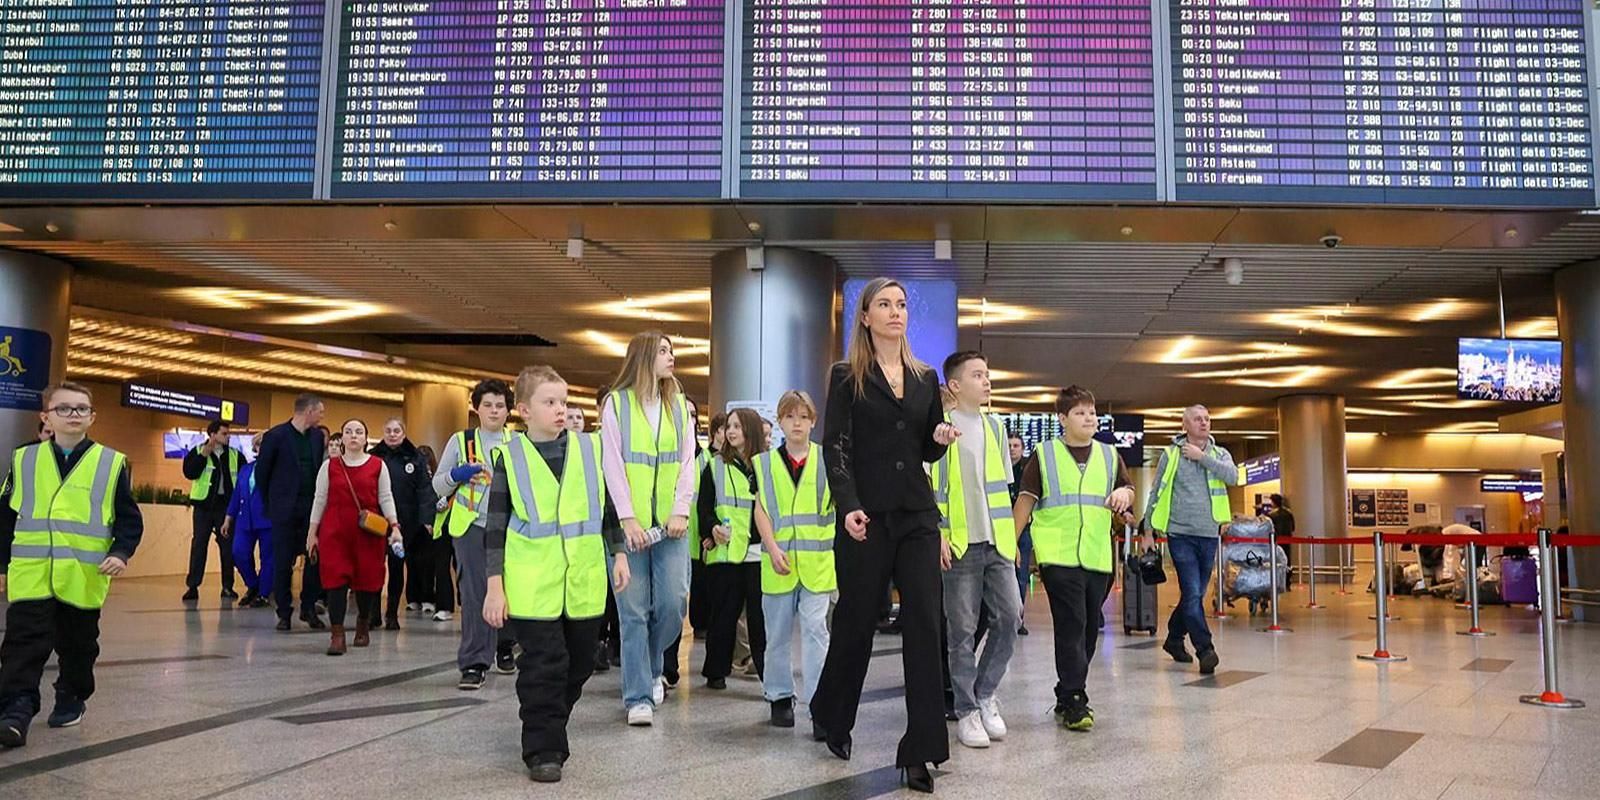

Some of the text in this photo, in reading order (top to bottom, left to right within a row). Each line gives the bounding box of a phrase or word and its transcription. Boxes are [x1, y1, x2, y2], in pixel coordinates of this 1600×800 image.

[130, 9, 145, 17] 414
[204, 7, 214, 16] 23
[754, 9, 782, 19] 21:35
[963, 9, 997, 18] 97-102
[1181, 11, 1210, 20] 23:55
[1393, 13, 1432, 22] 123-127
[512, 14, 529, 22] 423
[546, 13, 582, 22] 123-127
[129, 22, 144, 31] 617
[159, 22, 184, 31] 91-93
[753, 24, 782, 34] 21:40
[1181, 25, 1211, 35] 00:10
[351, 31, 376, 40] 19:00
[350, 41, 603, 54] 19:00 17
[753, 38, 1026, 48] 21:50 20
[1182, 39, 1211, 49] 00:20
[1446, 43, 1457, 52] 29
[349, 59, 375, 68] 19:00
[510, 56, 532, 65] 7137
[753, 53, 781, 62] 22:00
[1182, 54, 1212, 64] 00:20
[752, 67, 781, 76] 22:15
[348, 73, 373, 82] 19:30
[752, 82, 781, 91] 22:15
[1016, 82, 1027, 91] 19
[1184, 84, 1460, 96] 00:50 25
[346, 100, 372, 110] 19:45
[542, 98, 580, 107] 133-135
[752, 97, 781, 106] 22:20
[964, 97, 992, 106] 51-55
[1016, 97, 1027, 105] 25
[1184, 98, 1213, 107] 00:55
[345, 114, 371, 124] 20:10
[590, 112, 601, 121] 22
[752, 111, 781, 121] 22:25
[121, 118, 141, 127] 3116
[151, 117, 176, 126] 72-75
[196, 117, 207, 126] 23
[344, 129, 371, 138] 20:25
[590, 127, 600, 136] 15
[752, 126, 780, 135] 23:00
[1185, 128, 1215, 137] 01:10
[1364, 132, 1381, 140] 391
[1451, 132, 1463, 140] 20
[343, 143, 370, 153] 20:30
[751, 140, 1004, 150] 23:20 433 123-127
[1186, 143, 1464, 156] 01:15 51-55 24
[342, 156, 599, 167] 20:30 453 12
[1186, 158, 1215, 167] 01:20
[1454, 162, 1465, 171] 19
[147, 174, 172, 182] 51-53
[192, 173, 202, 181] 24
[751, 170, 780, 180] 23:35
[964, 172, 1009, 181] 92-94,91
[1186, 173, 1216, 183] 01:50
[1401, 176, 1431, 185] 51-55
[1454, 177, 1465, 186] 23
